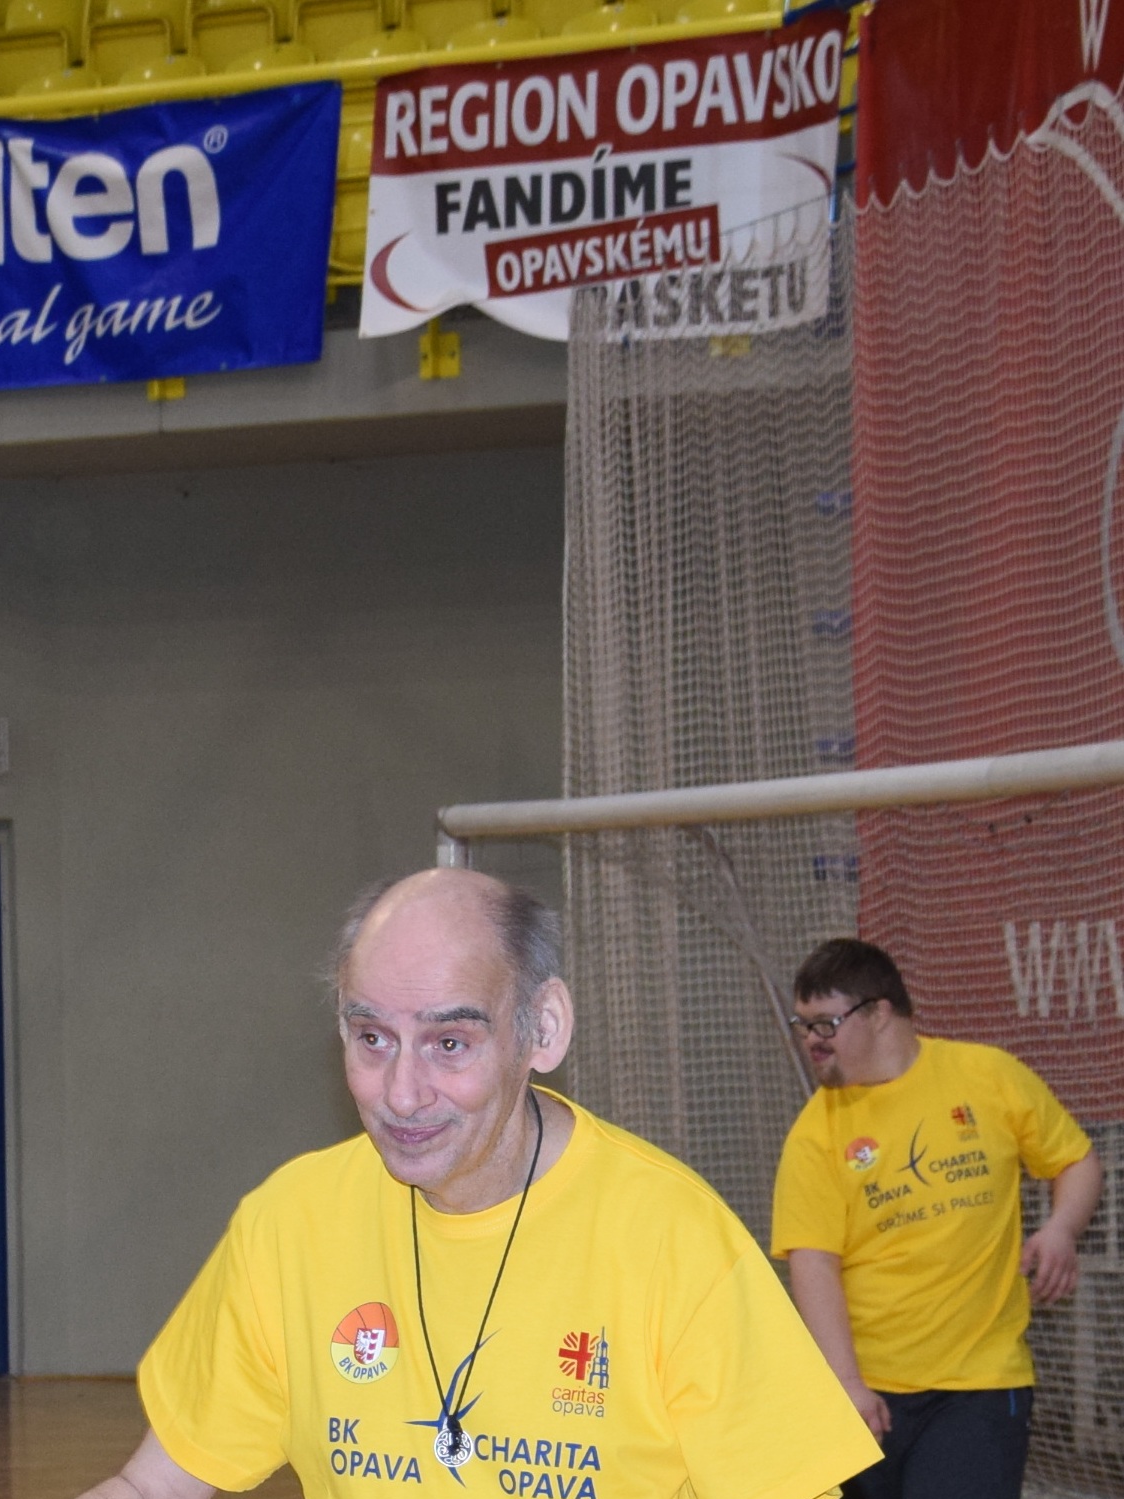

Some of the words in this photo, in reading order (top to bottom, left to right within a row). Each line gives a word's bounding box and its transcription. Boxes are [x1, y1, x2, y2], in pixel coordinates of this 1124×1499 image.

[384, 69, 599, 160] REGION
[615, 29, 843, 136] OPAVSKO
[435, 144, 693, 236] FANDÍME
[494, 217, 713, 293] OPAVSKÉMU
[64, 290, 223, 365] game
[929, 1150, 987, 1173] CHARITA
[945, 1164, 989, 1183] OPAVA
[868, 1184, 912, 1209] OPAVA
[338, 1356, 355, 1375] BK
[353, 1361, 388, 1380] OPAVA
[551, 1386, 605, 1405] caritas
[552, 1401, 605, 1418] opava
[328, 1417, 360, 1444] BK
[474, 1434, 602, 1471] CHARITA
[330, 1449, 422, 1484] OPAVA
